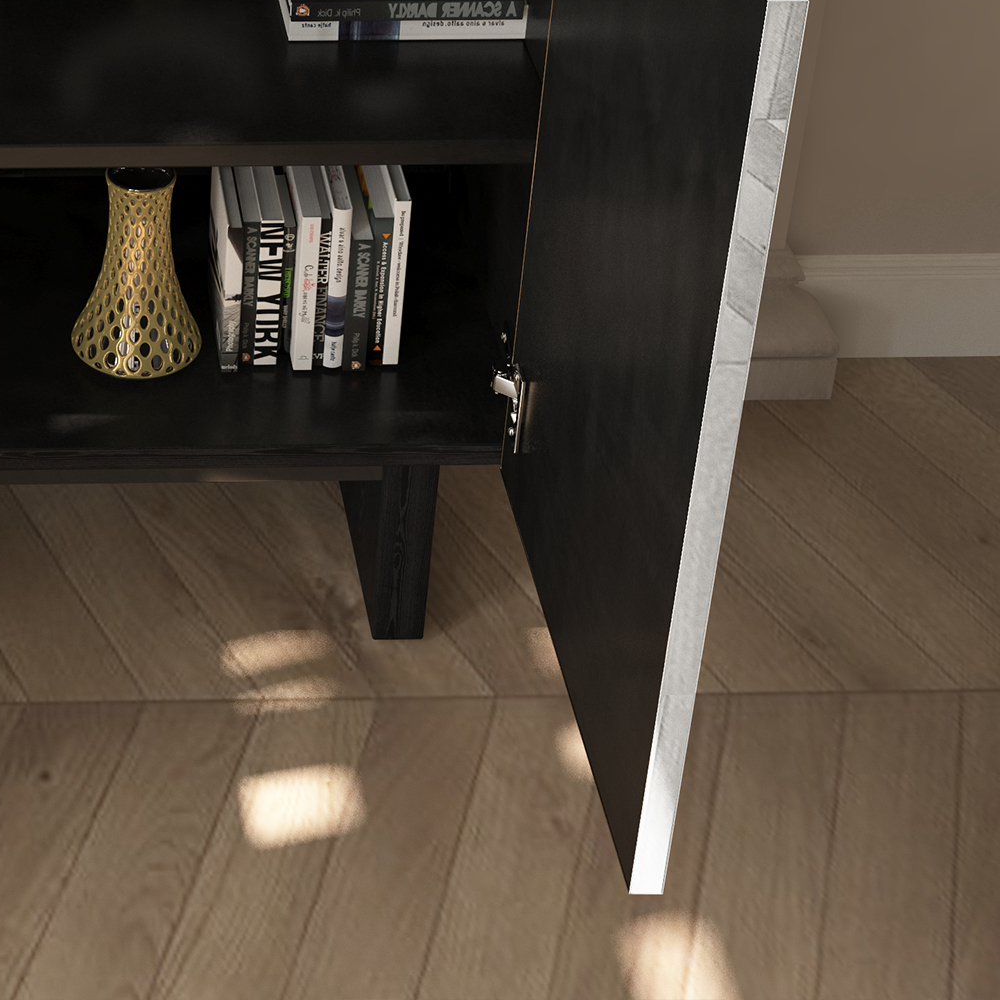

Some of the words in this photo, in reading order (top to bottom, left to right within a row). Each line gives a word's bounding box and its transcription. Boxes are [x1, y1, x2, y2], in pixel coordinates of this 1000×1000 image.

[246, 226, 258, 235] A
[244, 236, 258, 274] SCANNER
[259, 223, 284, 281] NEW
[317, 231, 332, 284] WALTER
[358, 243, 371, 251] A
[381, 241, 389, 260] Access
[355, 252, 371, 288] SCANNER
[379, 266, 387, 293] Expansion
[242, 276, 255, 307] DARKLY
[352, 289, 368, 318] DARKLY
[314, 285, 328, 342] FINANCE
[376, 300, 384, 317] Higher
[253, 294, 280, 359] YORK
[375, 318, 383, 344] Education
